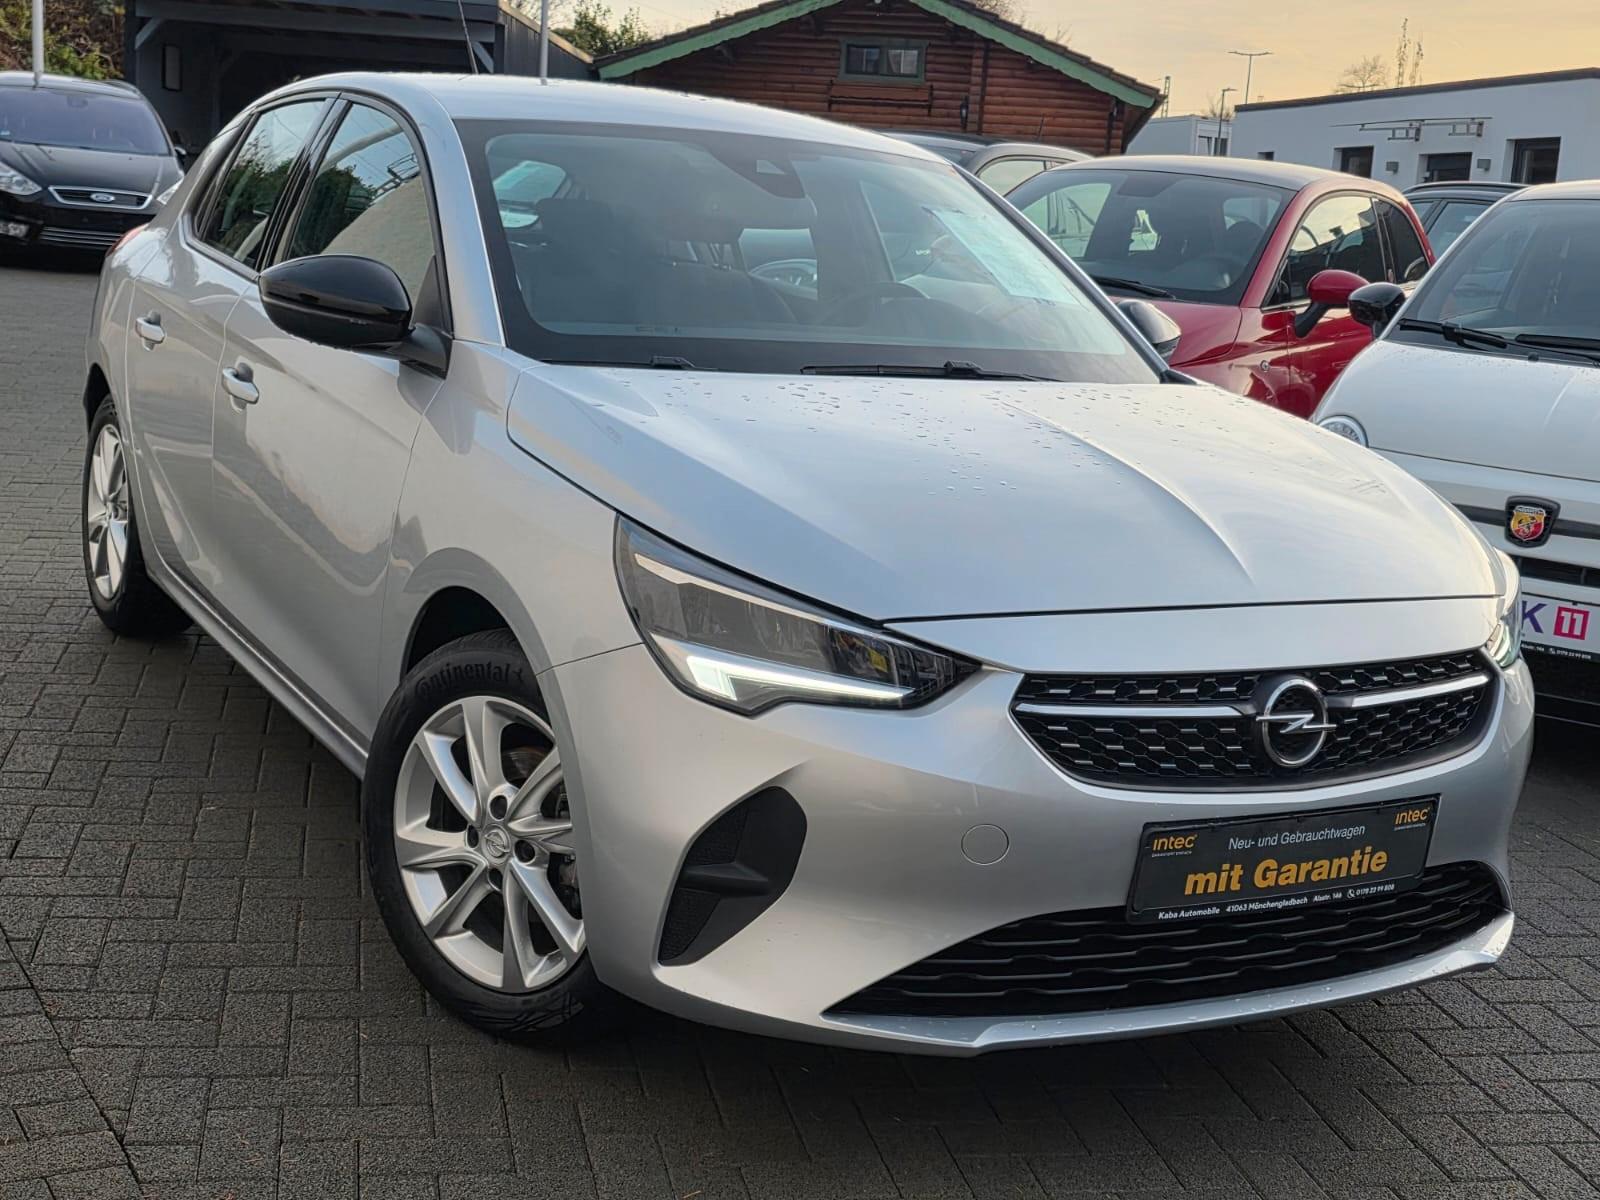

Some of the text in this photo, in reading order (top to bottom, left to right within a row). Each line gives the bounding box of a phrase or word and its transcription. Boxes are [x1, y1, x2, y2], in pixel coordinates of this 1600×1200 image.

[1560, 611, 1584, 635] 11
[1395, 808, 1429, 825] intec
[1153, 835, 1196, 850] intec
[1228, 825, 1366, 850] Neu- und Gebrauchtwagen
[1184, 846, 1388, 896] mit Garantie
[1158, 910, 1178, 920] Kaba
[1179, 907, 1220, 918] Automobile
[1226, 904, 1247, 913] 41063
[1248, 896, 1308, 911] Mönchengladbach
